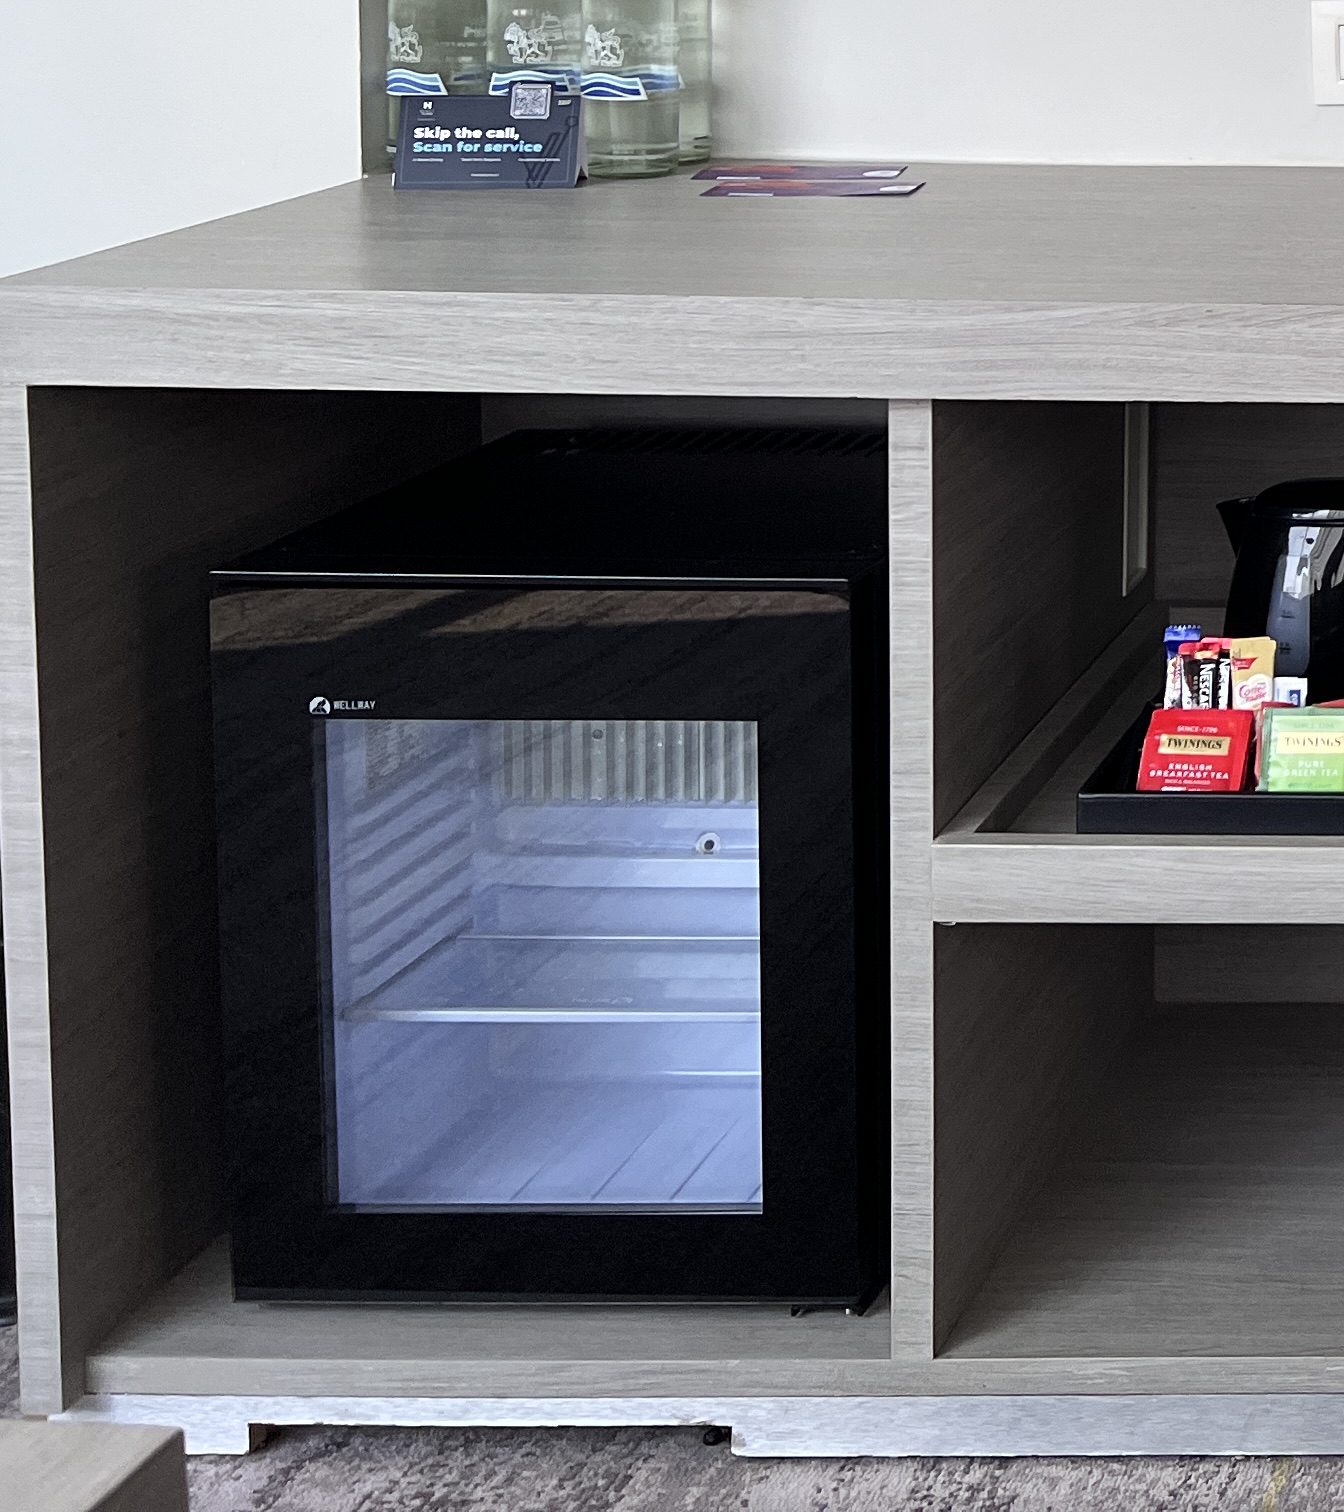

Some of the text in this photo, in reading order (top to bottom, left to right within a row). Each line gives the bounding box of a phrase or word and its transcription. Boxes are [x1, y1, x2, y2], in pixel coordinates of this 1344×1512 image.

[413, 126, 520, 140] Skip the call,
[413, 141, 543, 153] Scan for service
[1166, 737, 1223, 749] TWININGS
[1284, 736, 1342, 747] TWININGS
[1168, 763, 1213, 771] ENGLISH
[1149, 769, 1229, 780] BREAKFAST TEA
